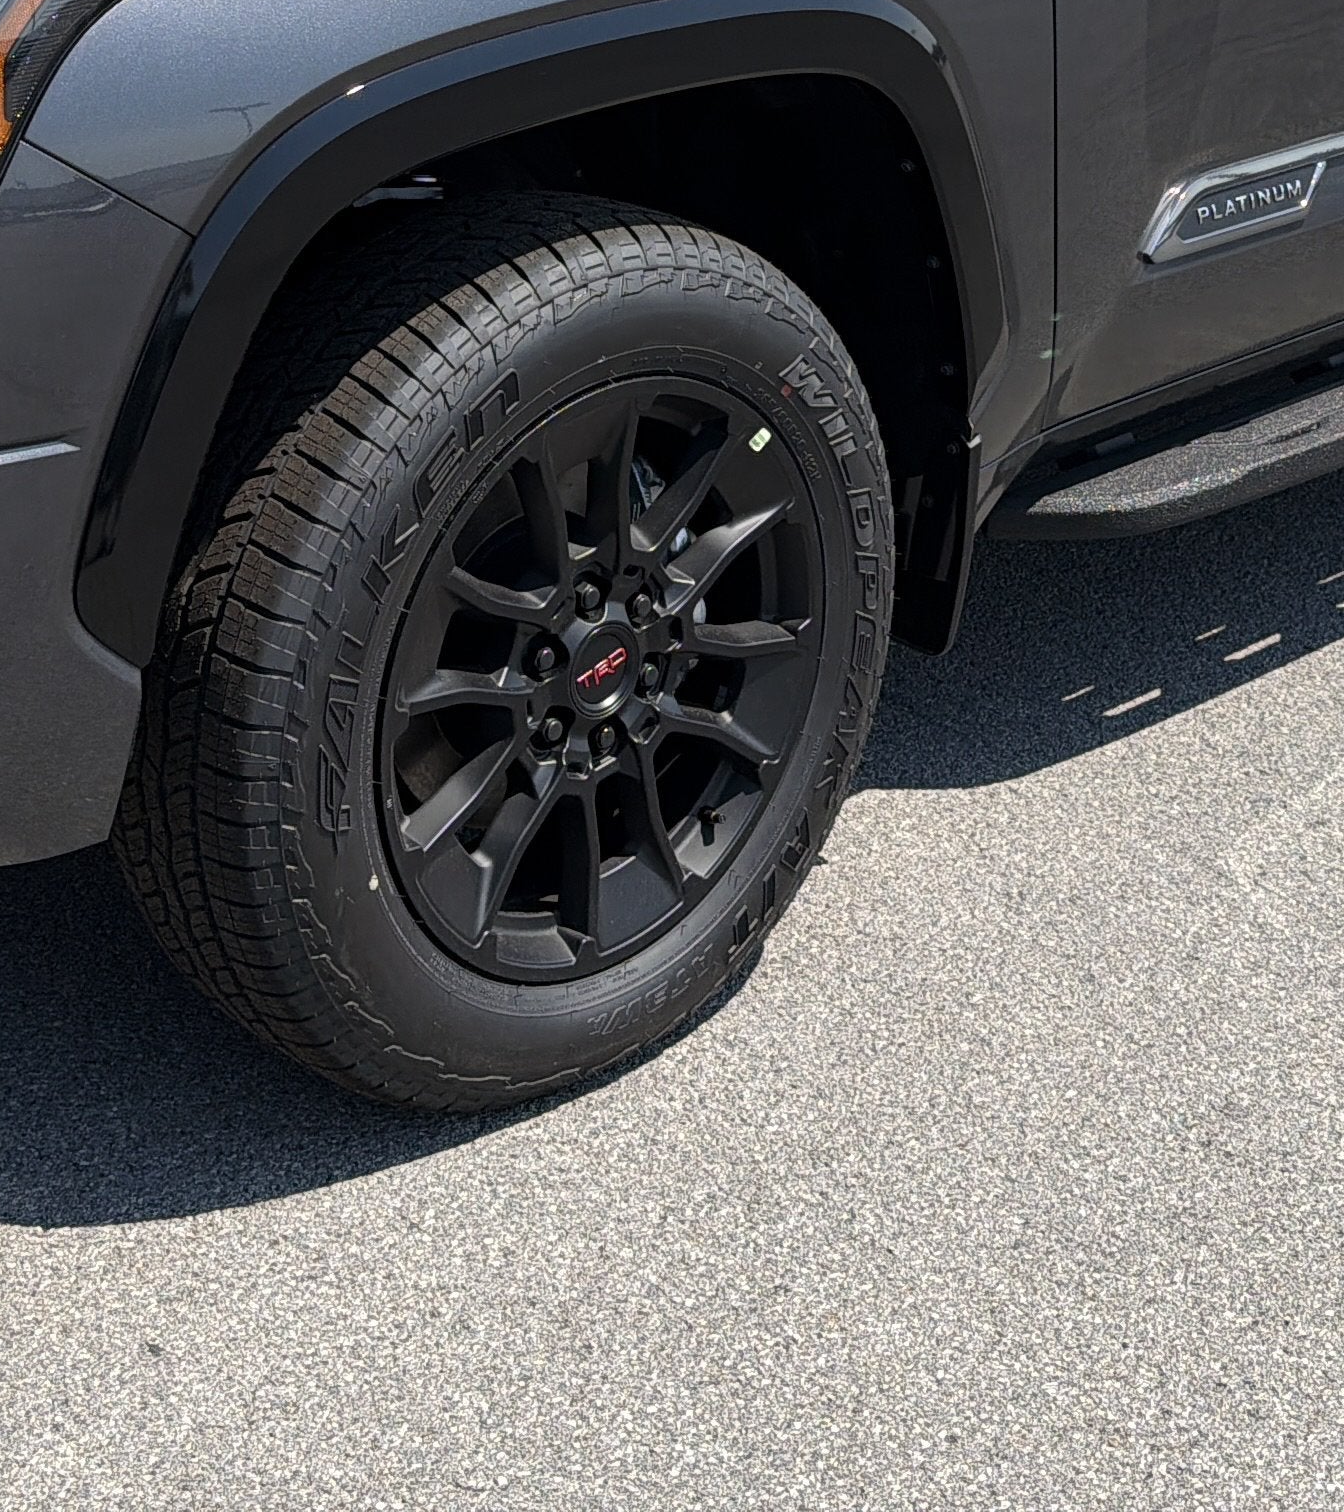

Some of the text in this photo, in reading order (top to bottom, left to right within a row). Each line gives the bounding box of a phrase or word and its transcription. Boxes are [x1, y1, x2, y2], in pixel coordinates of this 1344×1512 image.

[1197, 179, 1303, 225] PLATINUM
[779, 354, 878, 809] WILDPEAK
[576, 647, 627, 688] TRD
